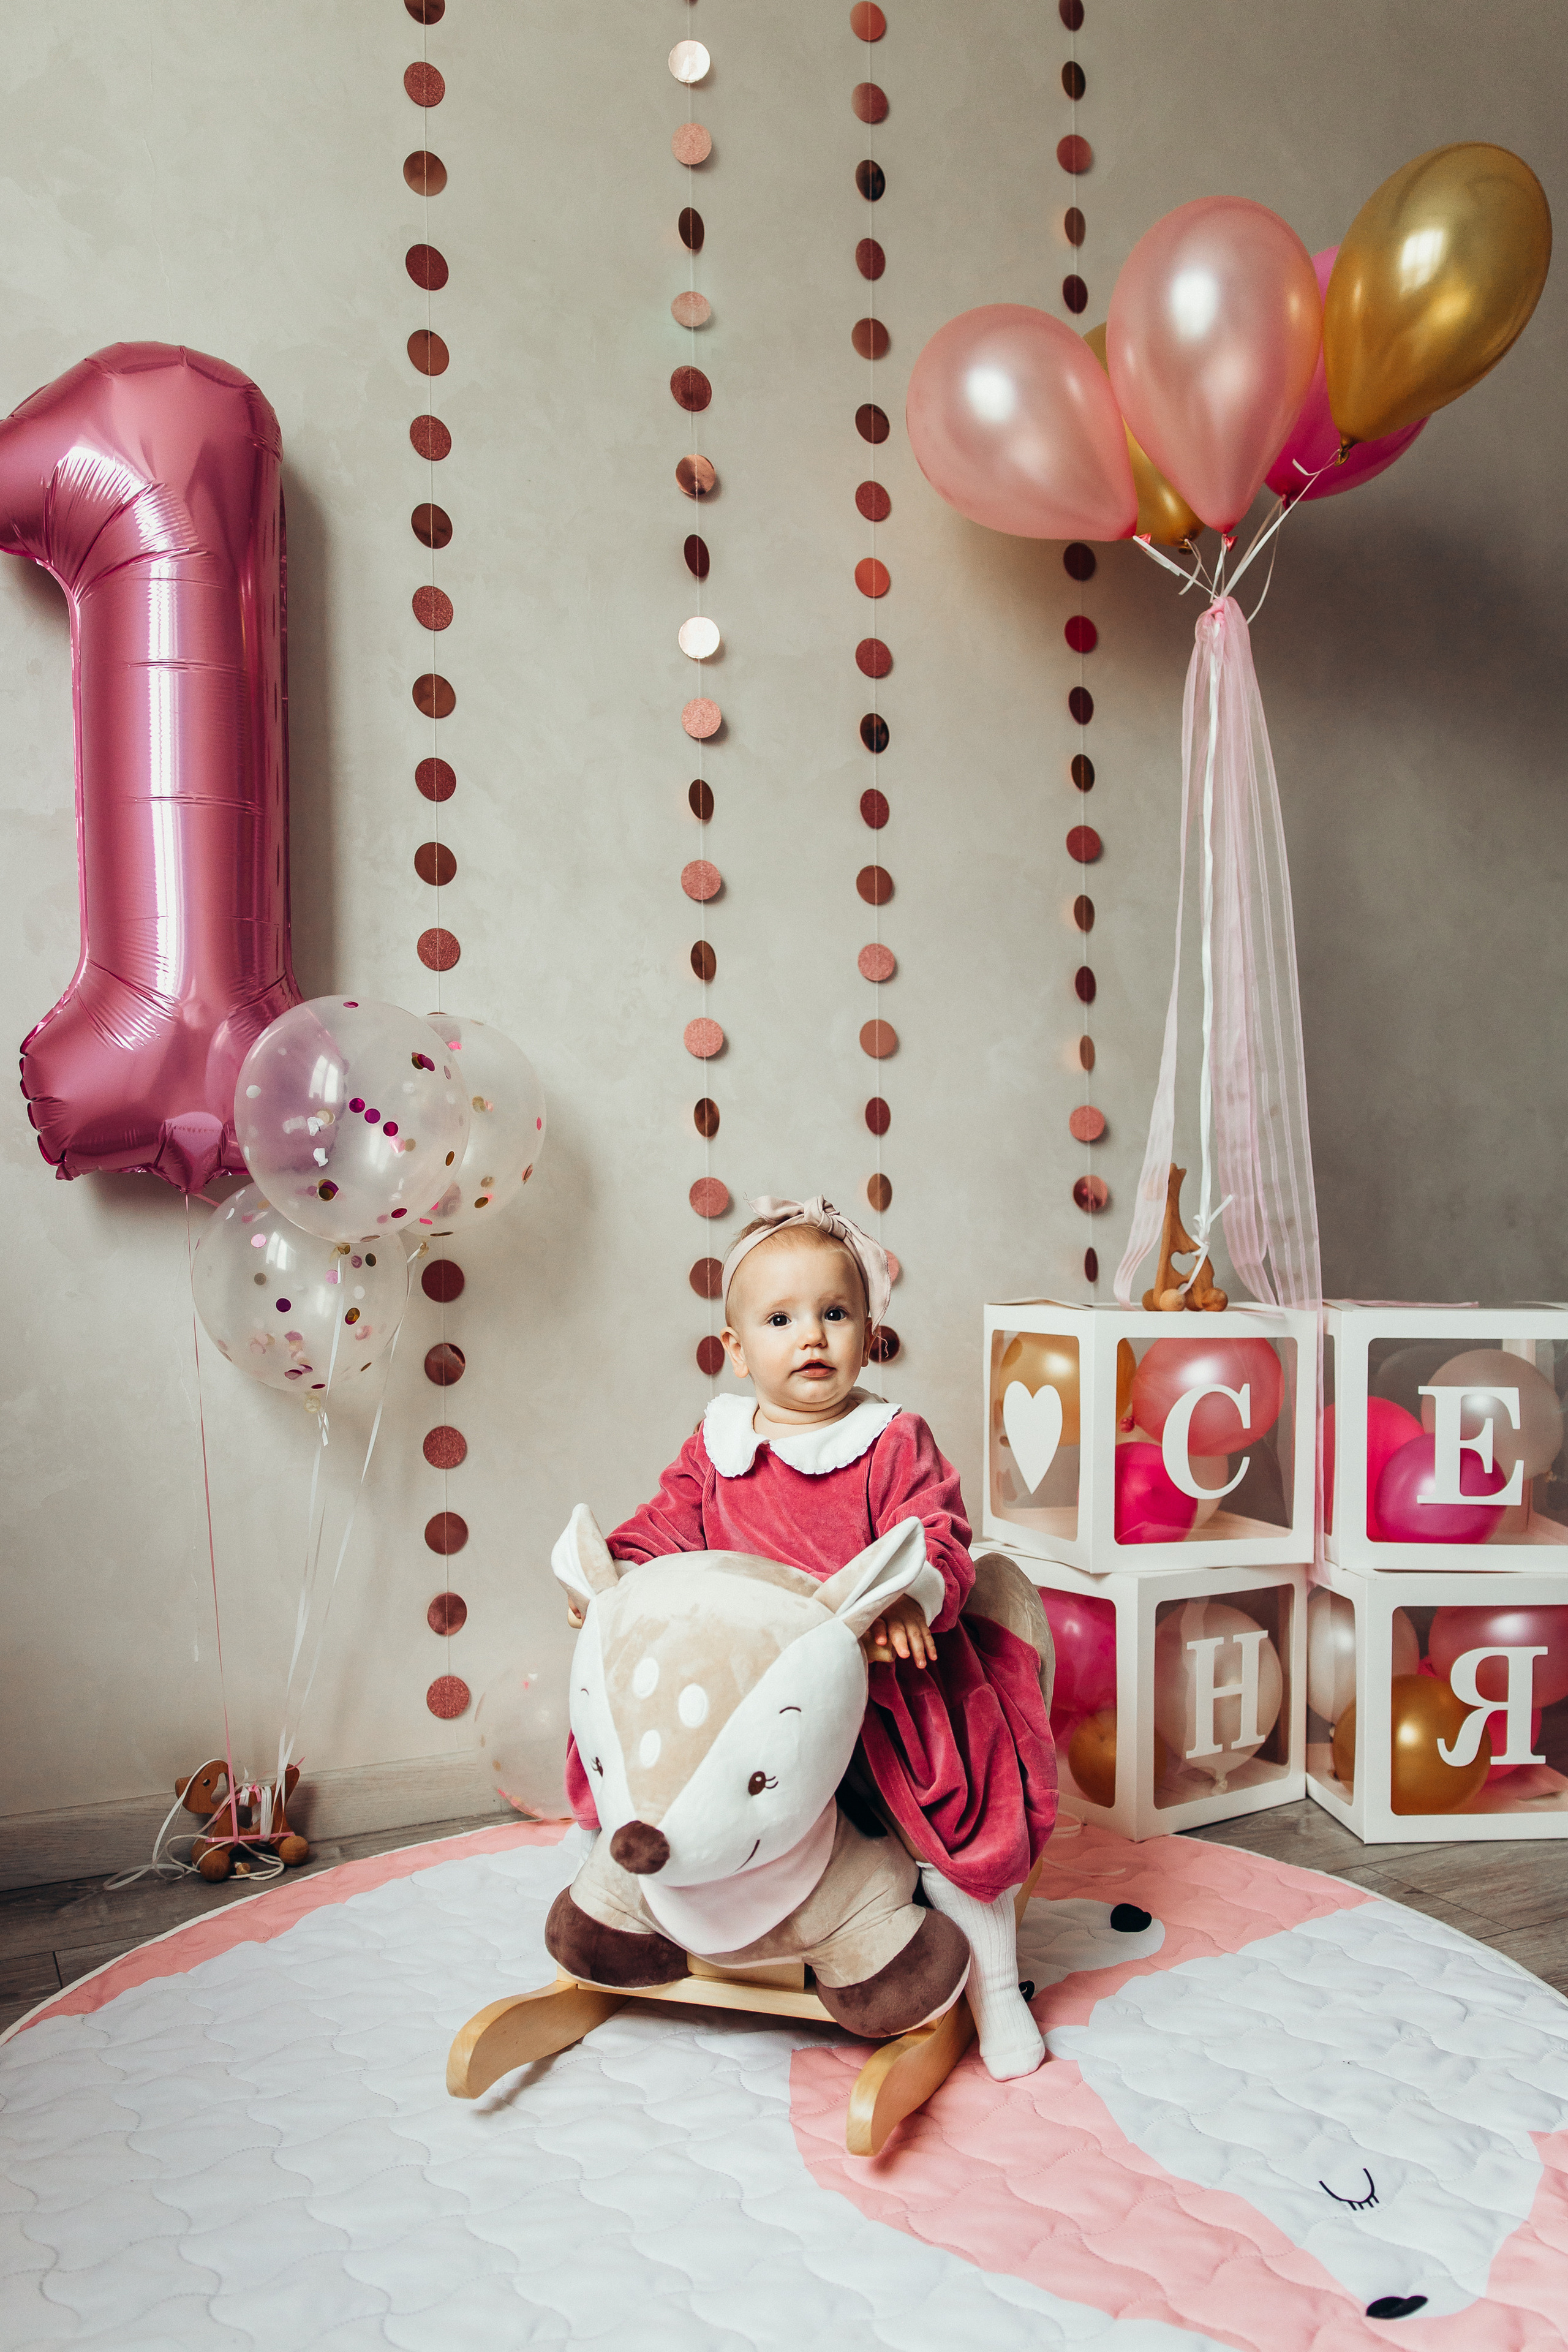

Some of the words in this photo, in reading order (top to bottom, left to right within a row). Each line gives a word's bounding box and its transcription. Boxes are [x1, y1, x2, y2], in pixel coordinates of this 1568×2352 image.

[1416, 1385, 1525, 1506] Е
[1186, 1629, 1269, 1760] Н
[1436, 1646, 1548, 1768] Я
